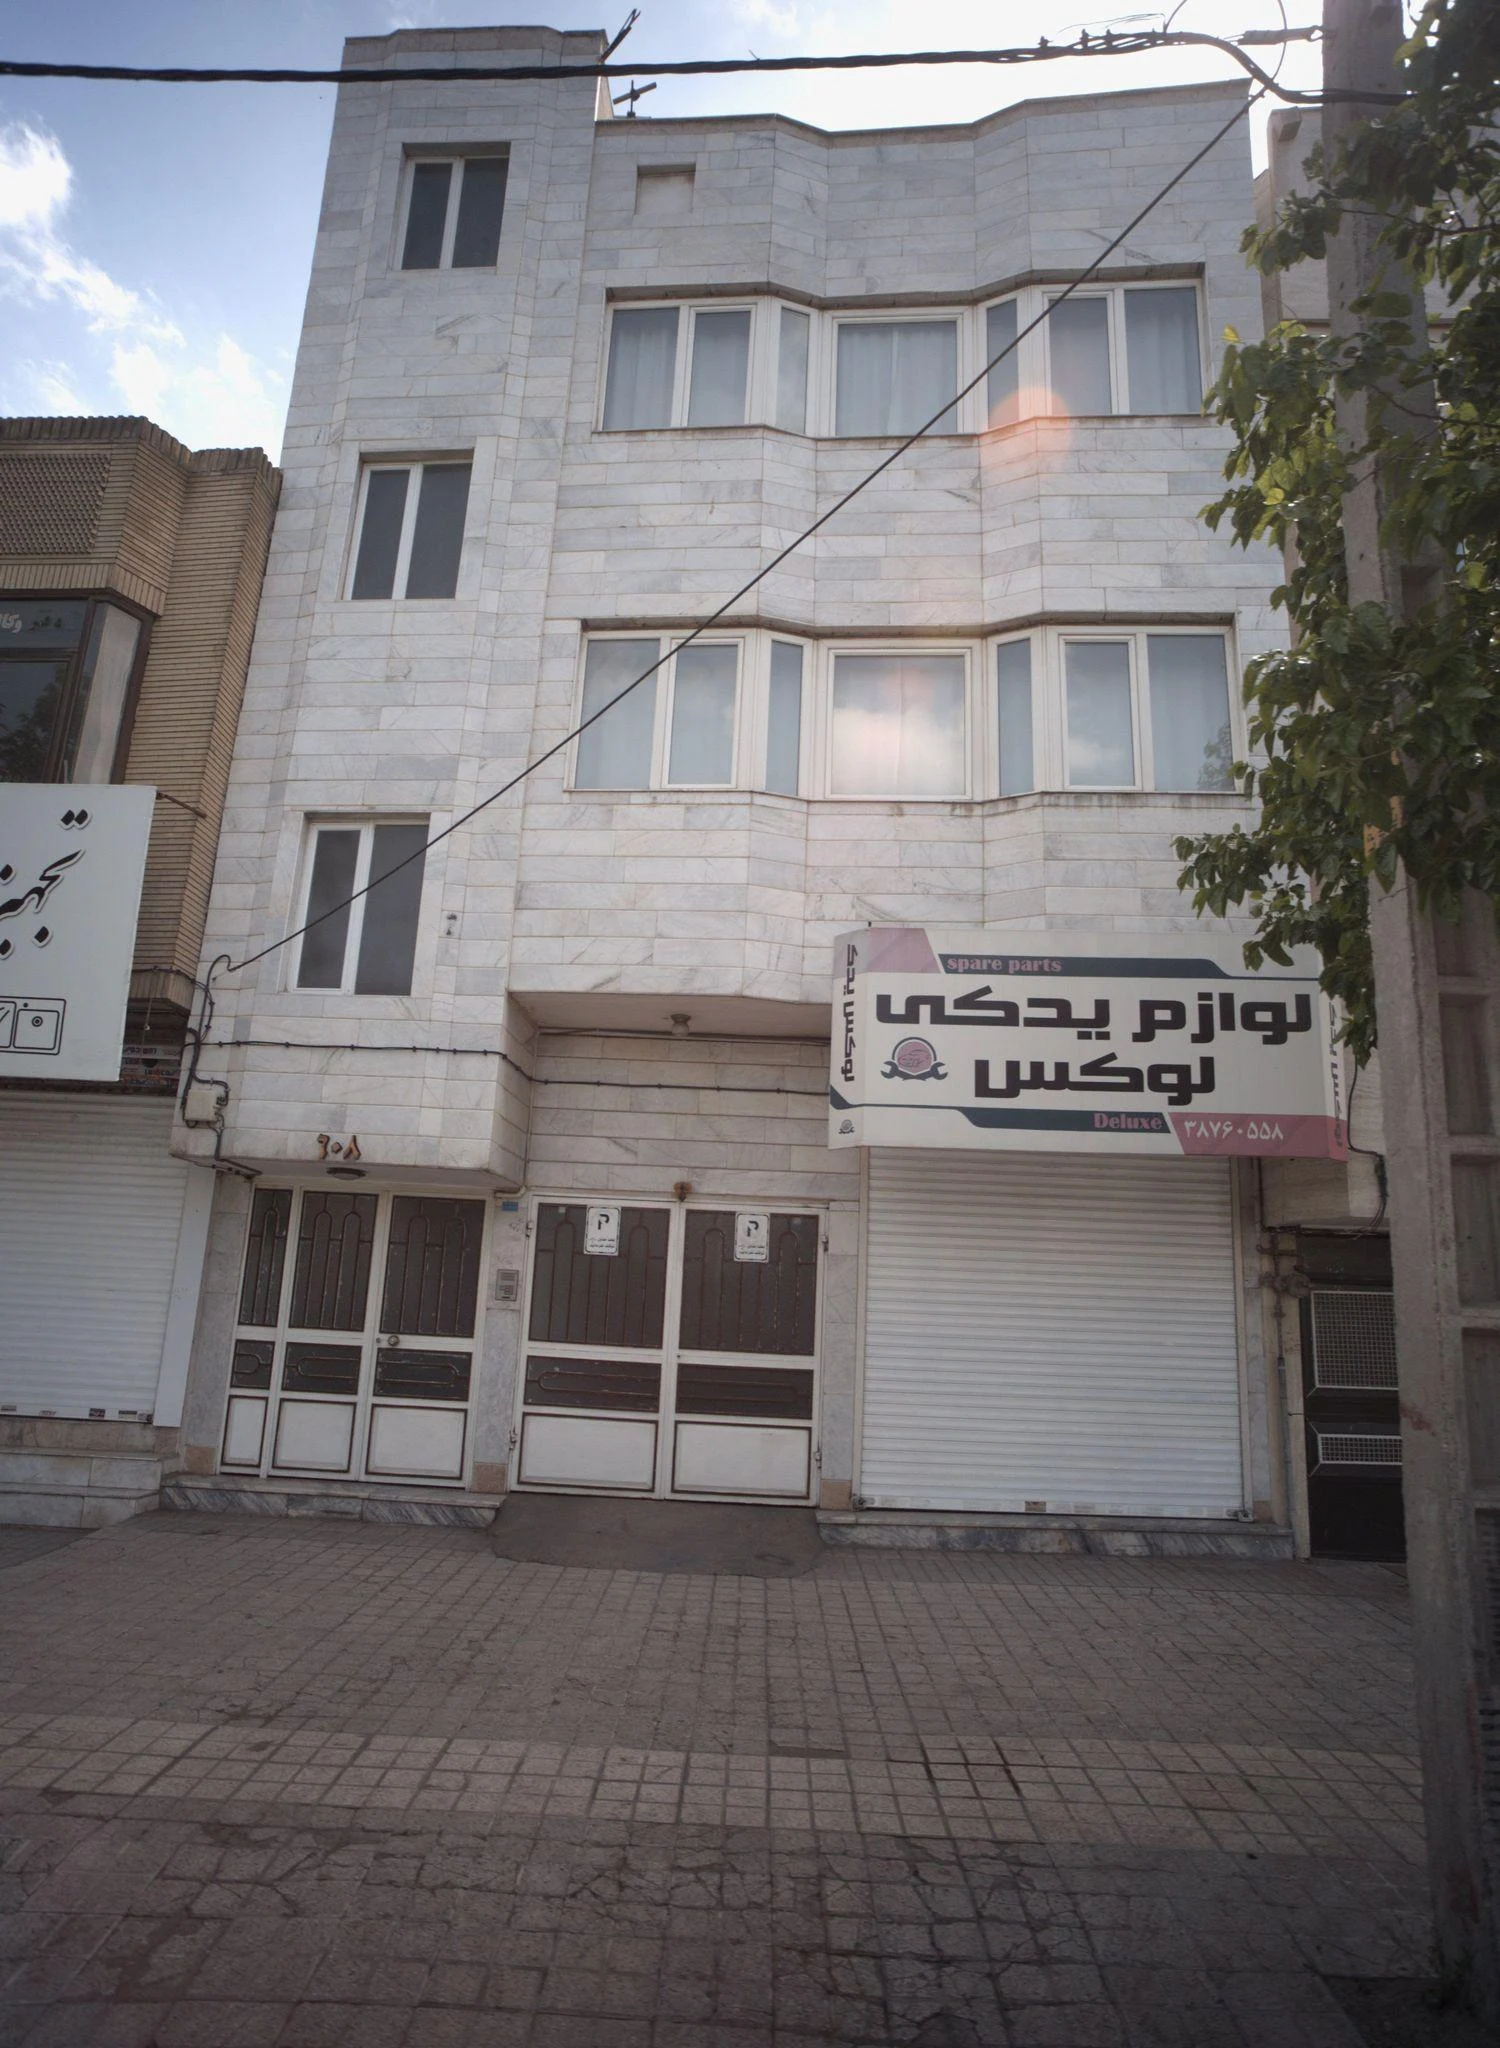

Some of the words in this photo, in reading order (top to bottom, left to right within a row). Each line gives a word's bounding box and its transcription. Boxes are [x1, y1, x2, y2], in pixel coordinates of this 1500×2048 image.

[946, 957, 1003, 973] spare
[1008, 958, 1063, 975] parts
[876, 984, 1111, 1041] یدکی
[1131, 992, 1312, 1045] لوازم
[974, 1051, 1216, 1106] لوکس
[1093, 1113, 1164, 1130] Deluxe
[1184, 1120, 1284, 1141] ۳۸۷۶۰۵۵۸
